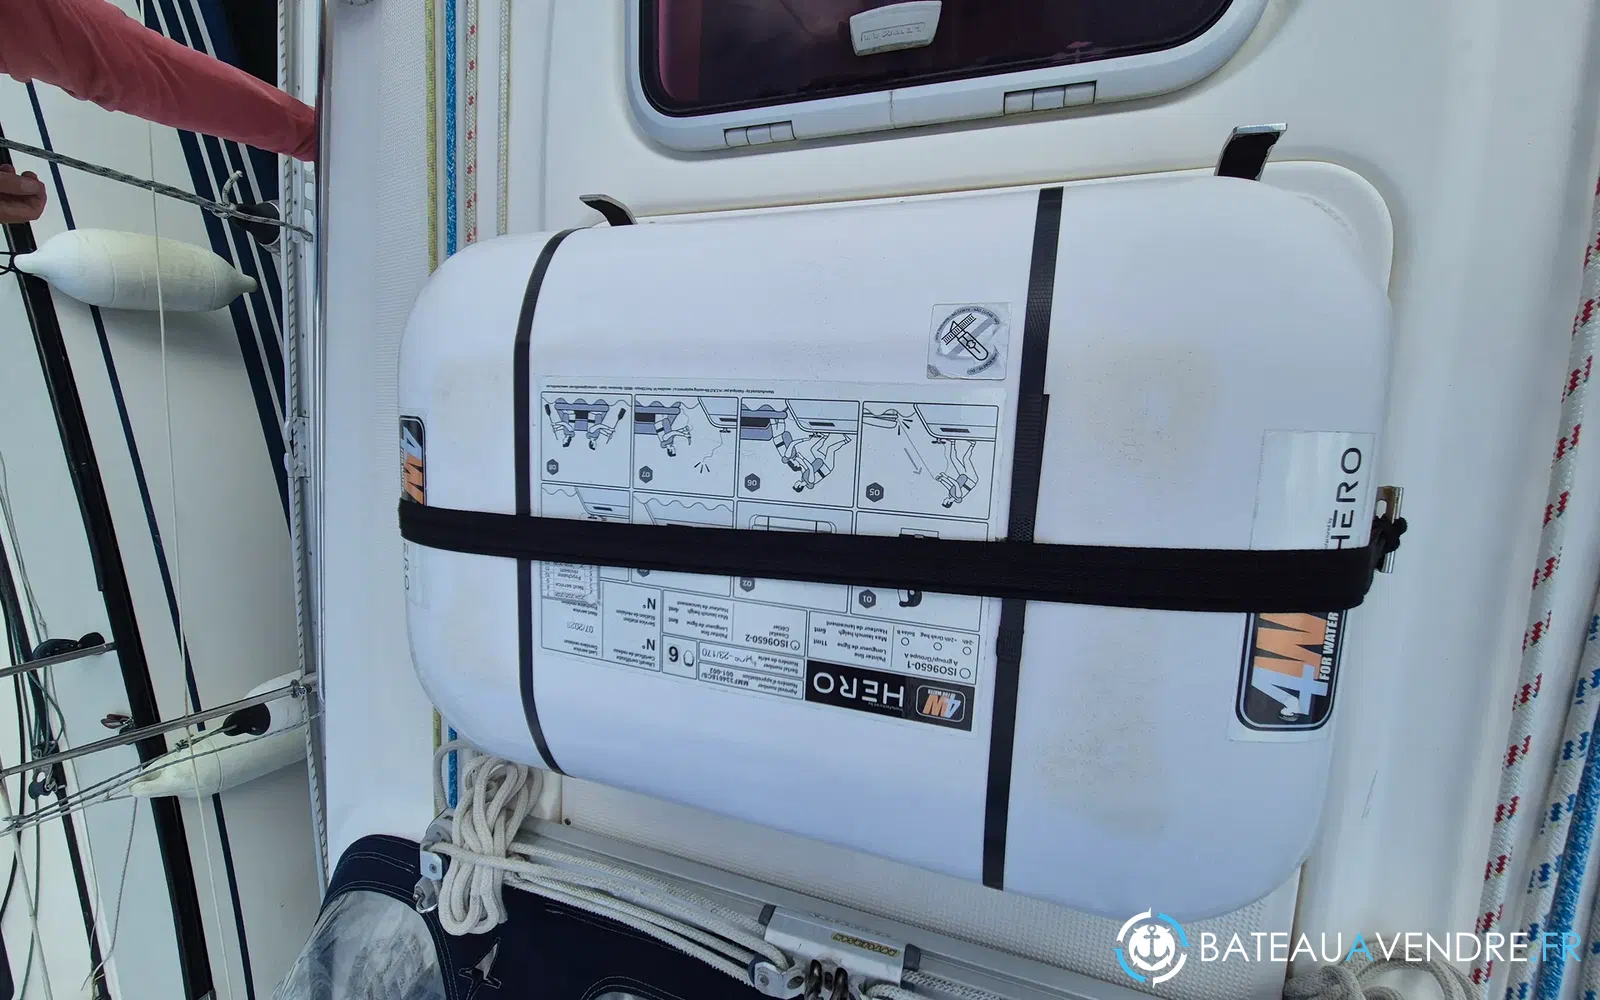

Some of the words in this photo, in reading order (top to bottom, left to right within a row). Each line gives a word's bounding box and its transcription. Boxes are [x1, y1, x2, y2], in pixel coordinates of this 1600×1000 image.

[869, 488, 880, 497] 05
[742, 579, 752, 587] 02
[642, 598, 656, 610] N°
[826, 621, 856, 629] lancement
[864, 626, 888, 634] Hauteur
[838, 629, 852, 637] heigh
[854, 632, 874, 640] launch
[1322, 612, 1339, 655] WATER
[641, 638, 655, 651] N°
[744, 634, 789, 648] ISO9650-2
[668, 646, 679, 663] 6
[859, 646, 887, 655] Longueur
[865, 654, 886, 662] Painter
[907, 661, 957, 676] ISO9650-1
[1320, 657, 1332, 680] FOR
[757, 683, 777, 691] number
[813, 672, 905, 708] HERO
[922, 695, 961, 719] 4W
